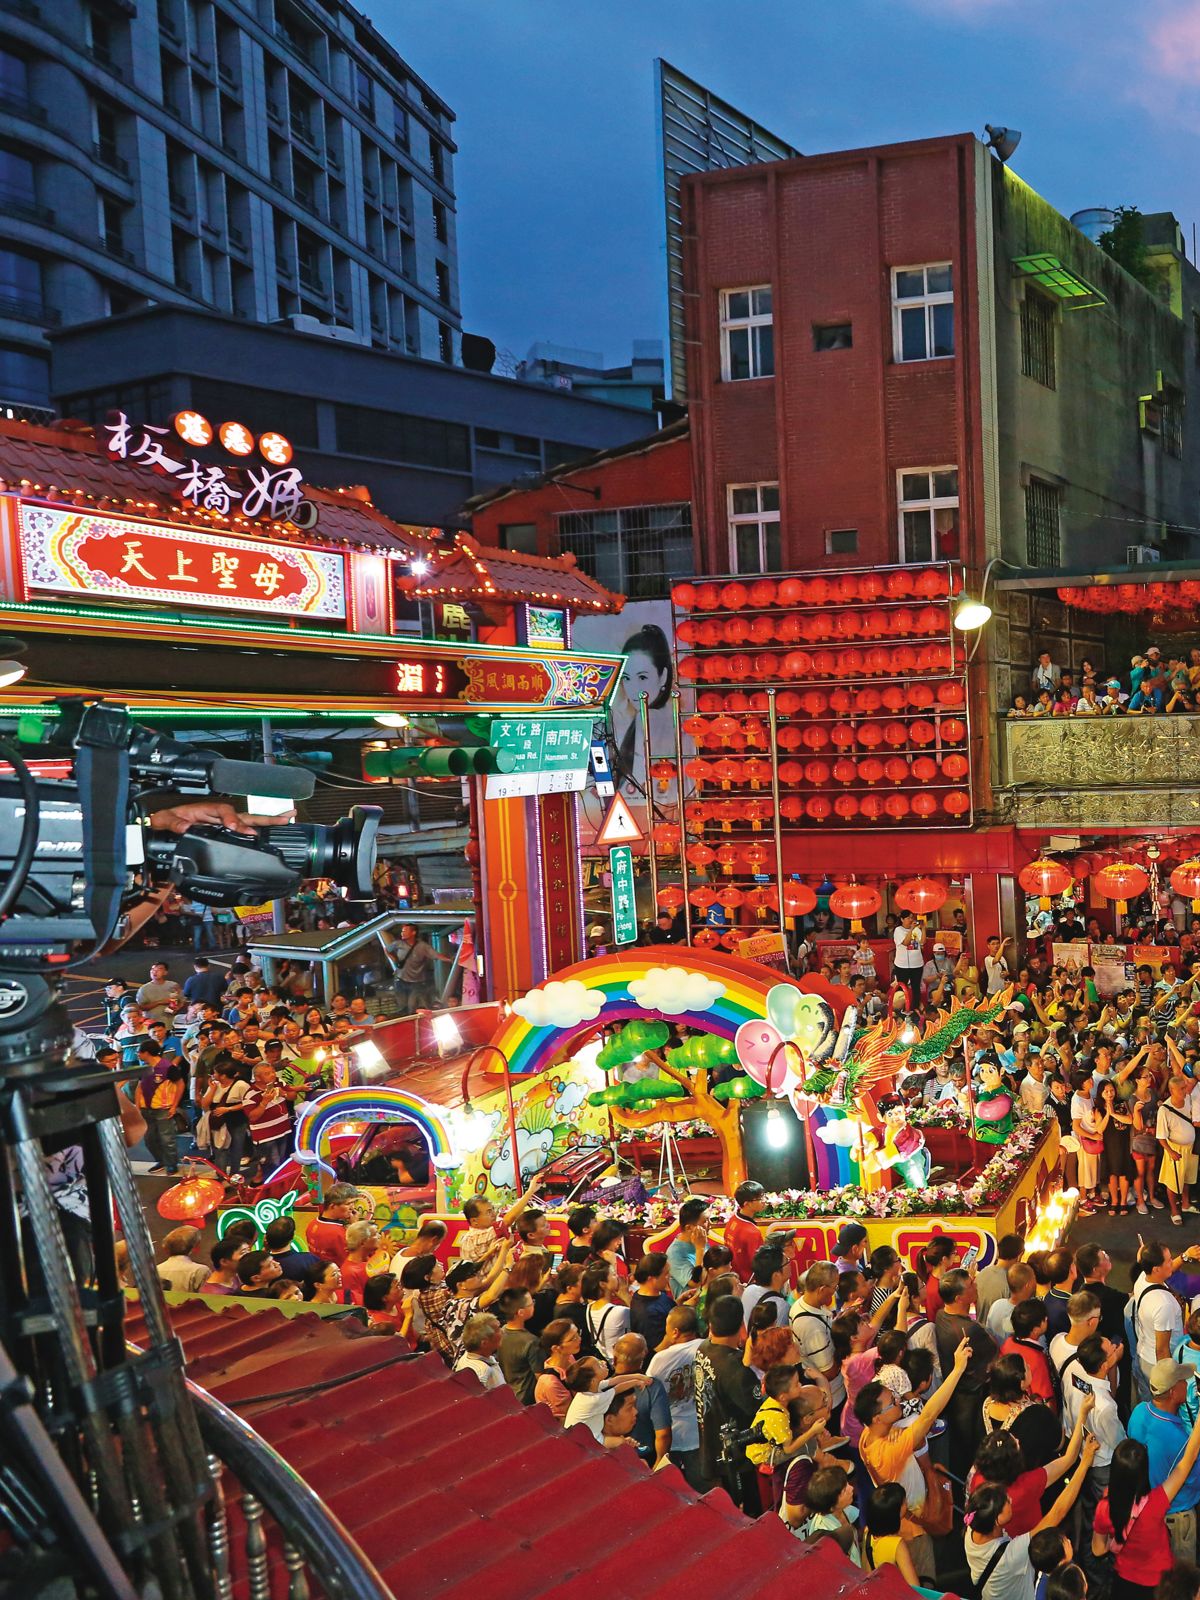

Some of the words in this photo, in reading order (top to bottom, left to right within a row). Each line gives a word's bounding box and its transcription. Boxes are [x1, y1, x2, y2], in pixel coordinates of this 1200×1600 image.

[179, 413, 289, 463] 慈惠宮
[105, 412, 318, 529] 板橋媽
[120, 541, 285, 595] 天上聖母
[486, 673, 543, 691] 風調雨順
[500, 722, 541, 737] 文化路
[545, 729, 583, 746] 南門街
[507, 739, 532, 750] 一段
[190, 886, 225, 898] Canon
[616, 860, 629, 910] 府中路
